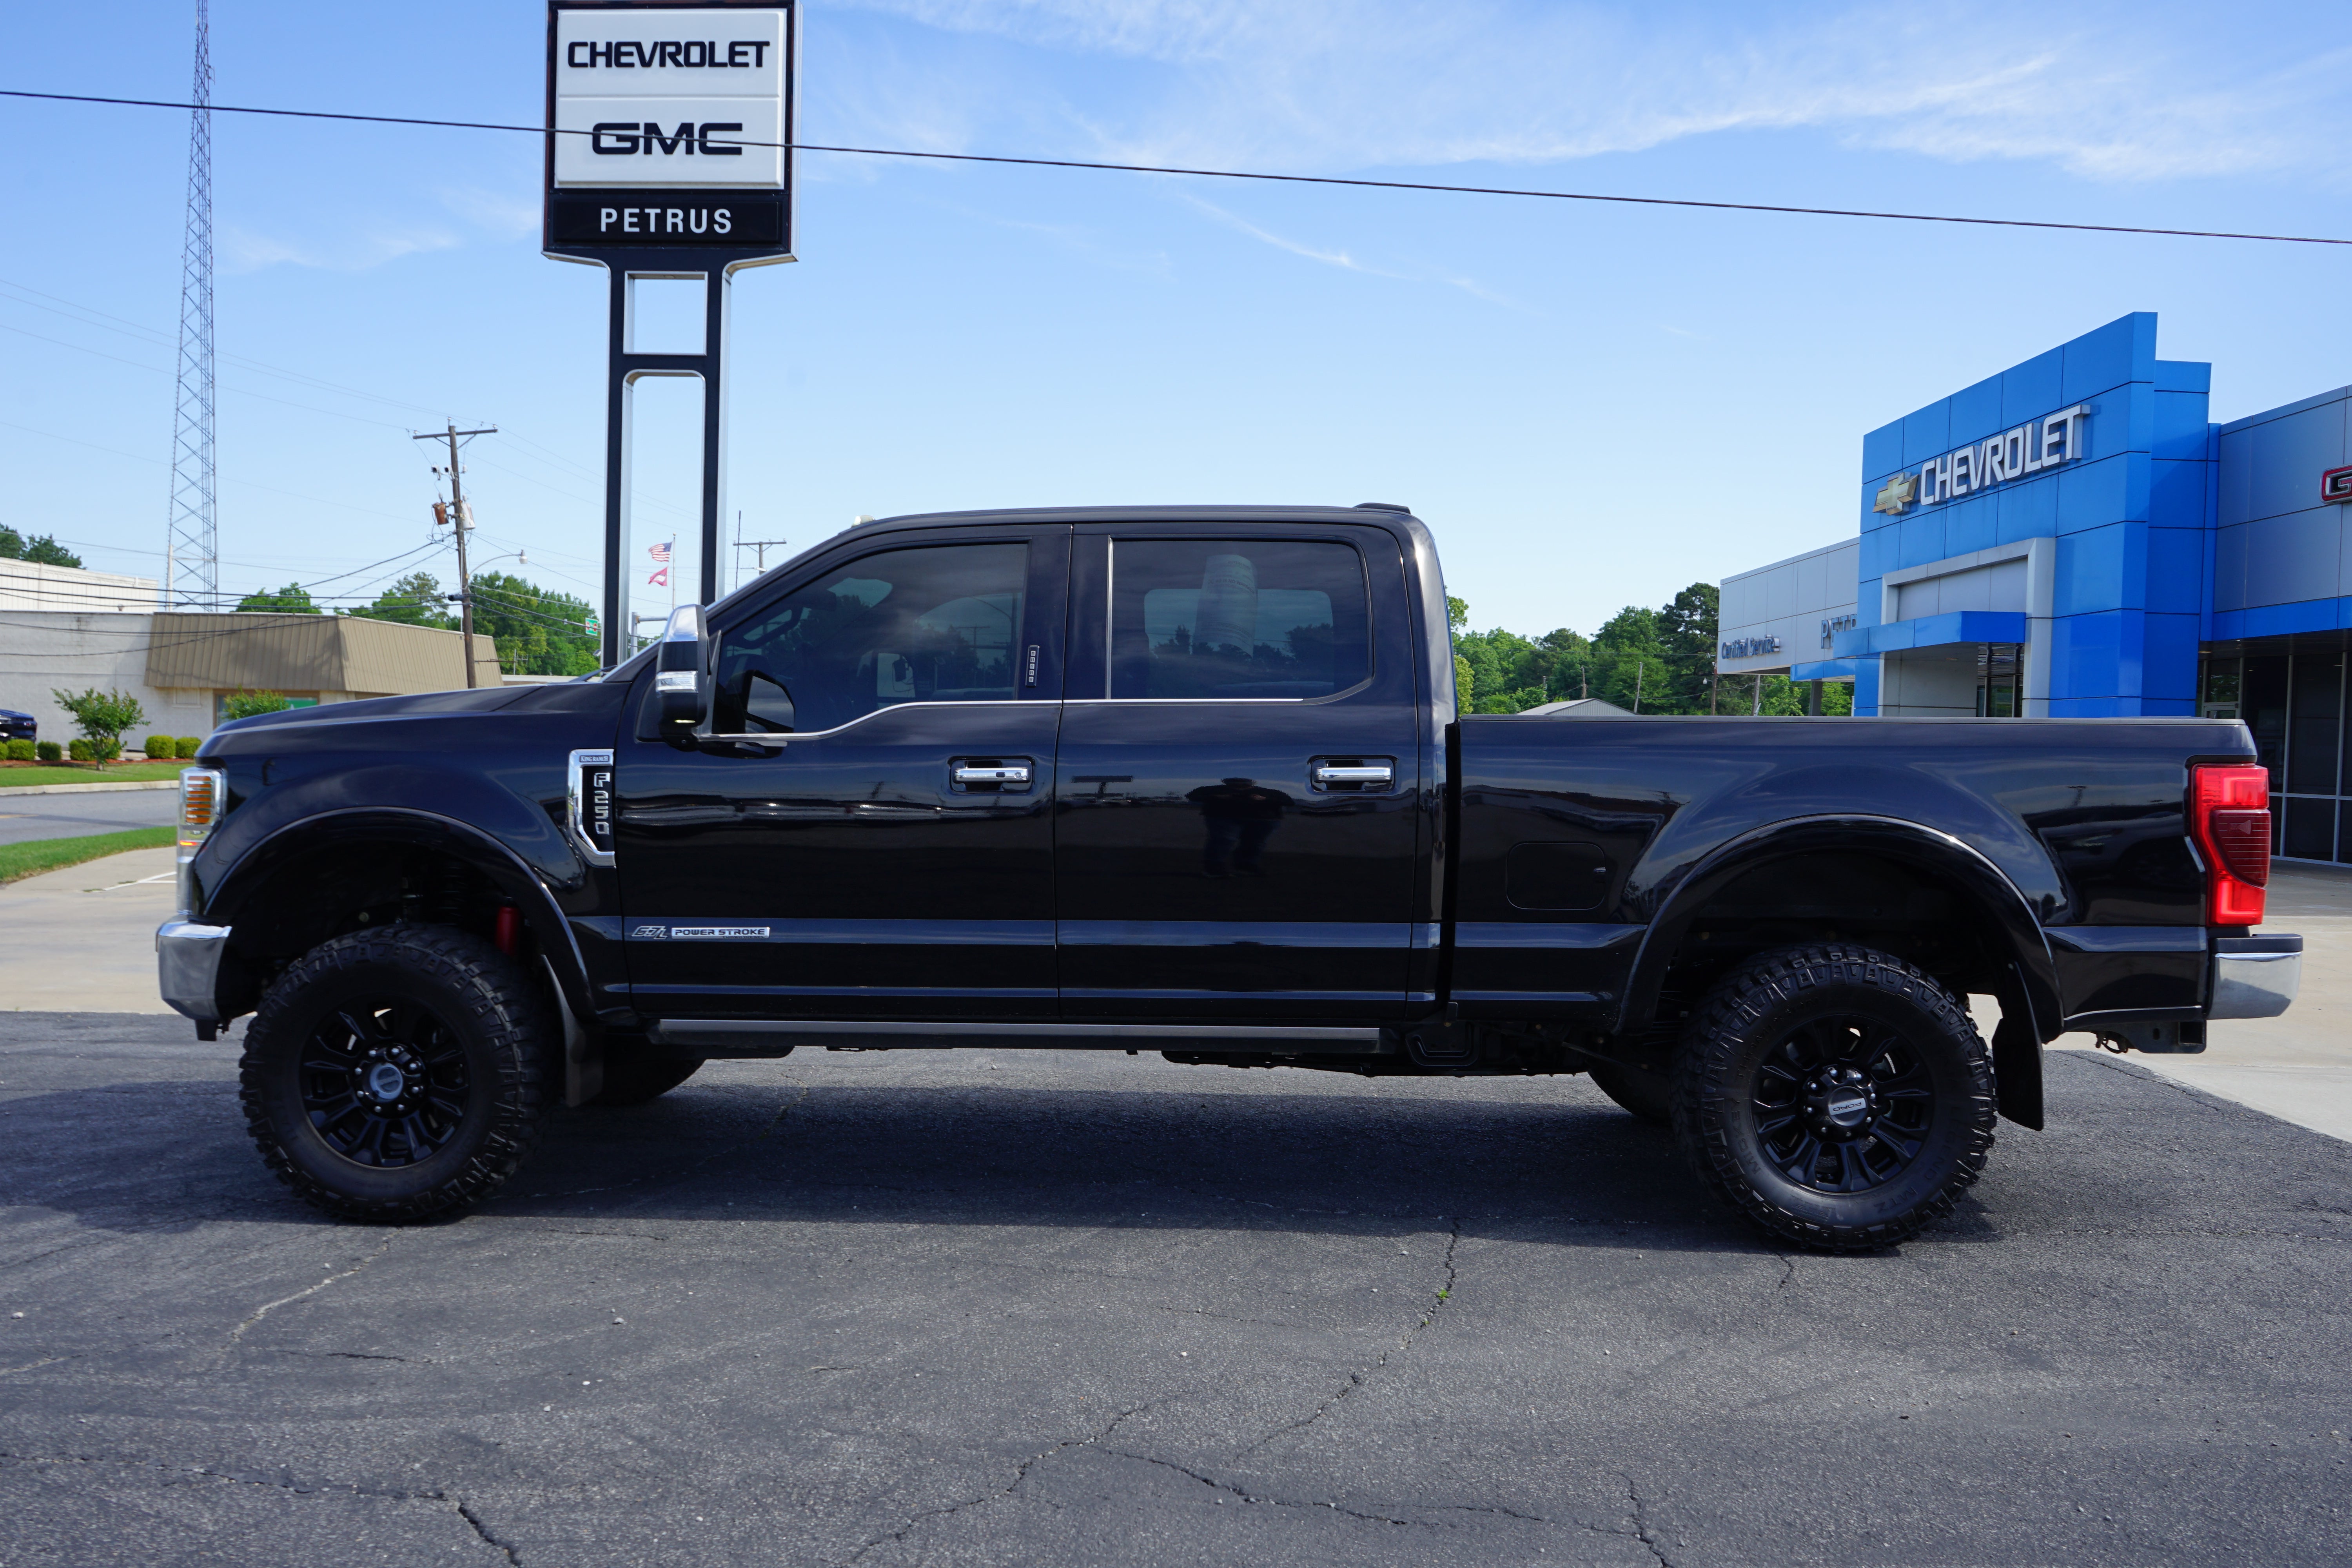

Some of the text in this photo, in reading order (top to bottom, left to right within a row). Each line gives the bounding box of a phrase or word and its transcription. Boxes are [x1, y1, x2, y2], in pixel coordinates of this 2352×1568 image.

[568, 41, 770, 68] CHEVROLET
[592, 123, 742, 155] GMC
[601, 208, 731, 234] PETRUS
[1921, 405, 2090, 506] CHEVROLET
[1749, 634, 1780, 655] Service
[1833, 1102, 1862, 1111] FORD
